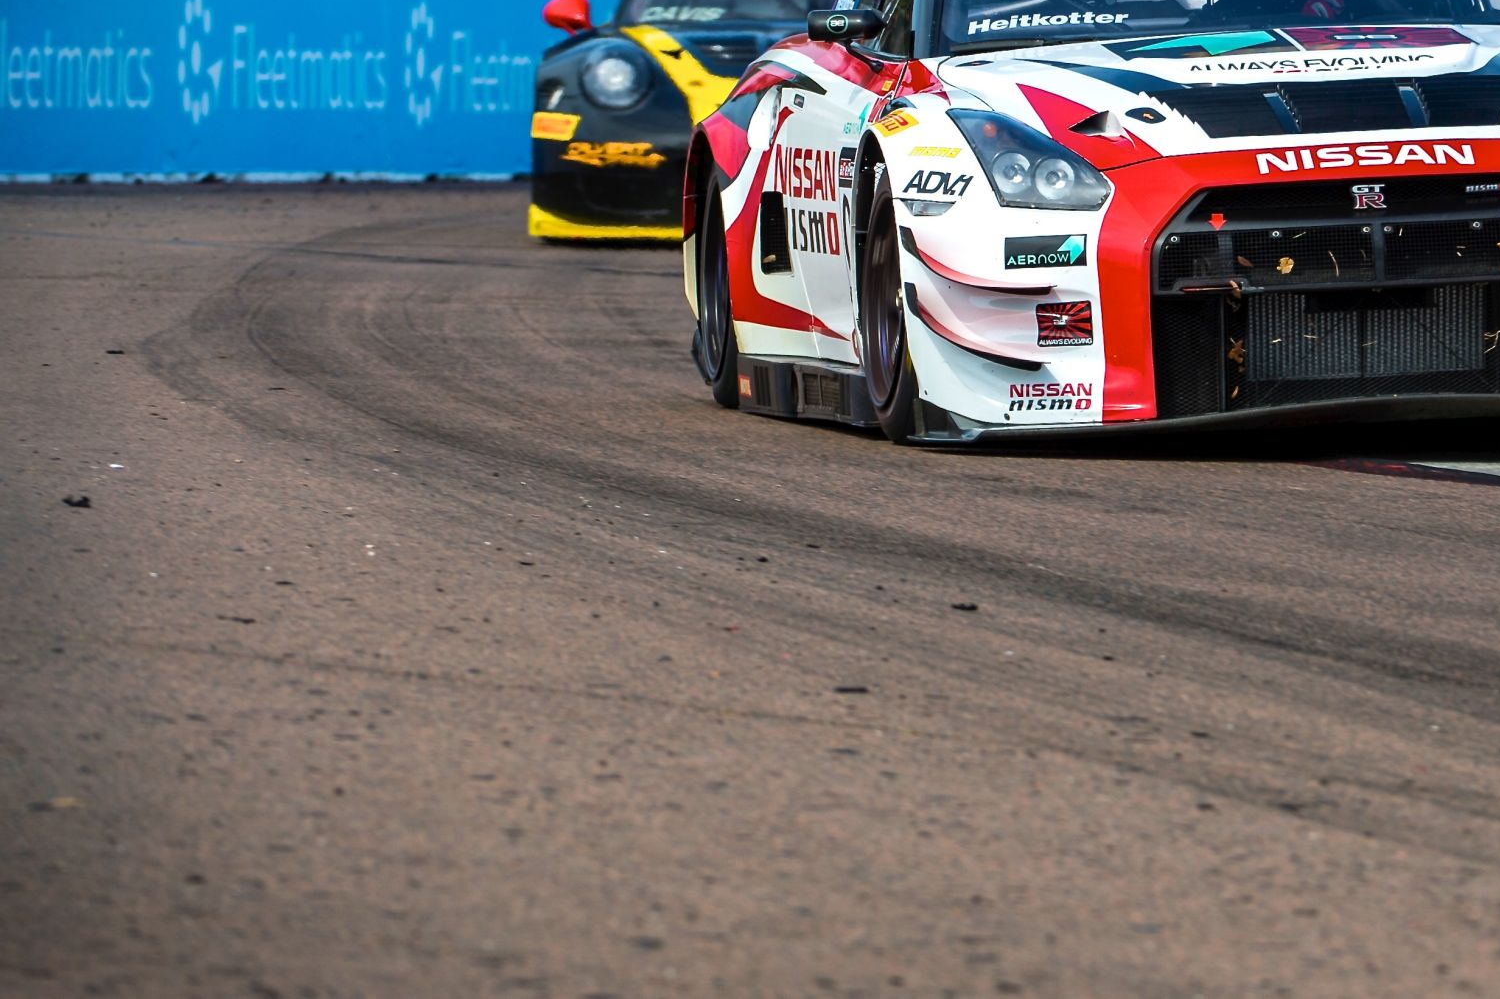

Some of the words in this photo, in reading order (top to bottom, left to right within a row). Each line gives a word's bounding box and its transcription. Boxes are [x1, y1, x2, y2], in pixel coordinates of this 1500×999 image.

[967, 11, 1129, 36] Heitkotter
[233, 22, 387, 109] Fleetmatics
[1256, 144, 1476, 175] NISSAN
[773, 143, 837, 202] NISSAN
[902, 169, 974, 197] ADV.1
[1352, 184, 1386, 194] GT
[1354, 193, 1387, 210] R
[1039, 338, 1064, 346] ALWAYS
[1064, 337, 1093, 345] EVOLVING
[1009, 383, 1093, 398] NISSAN
